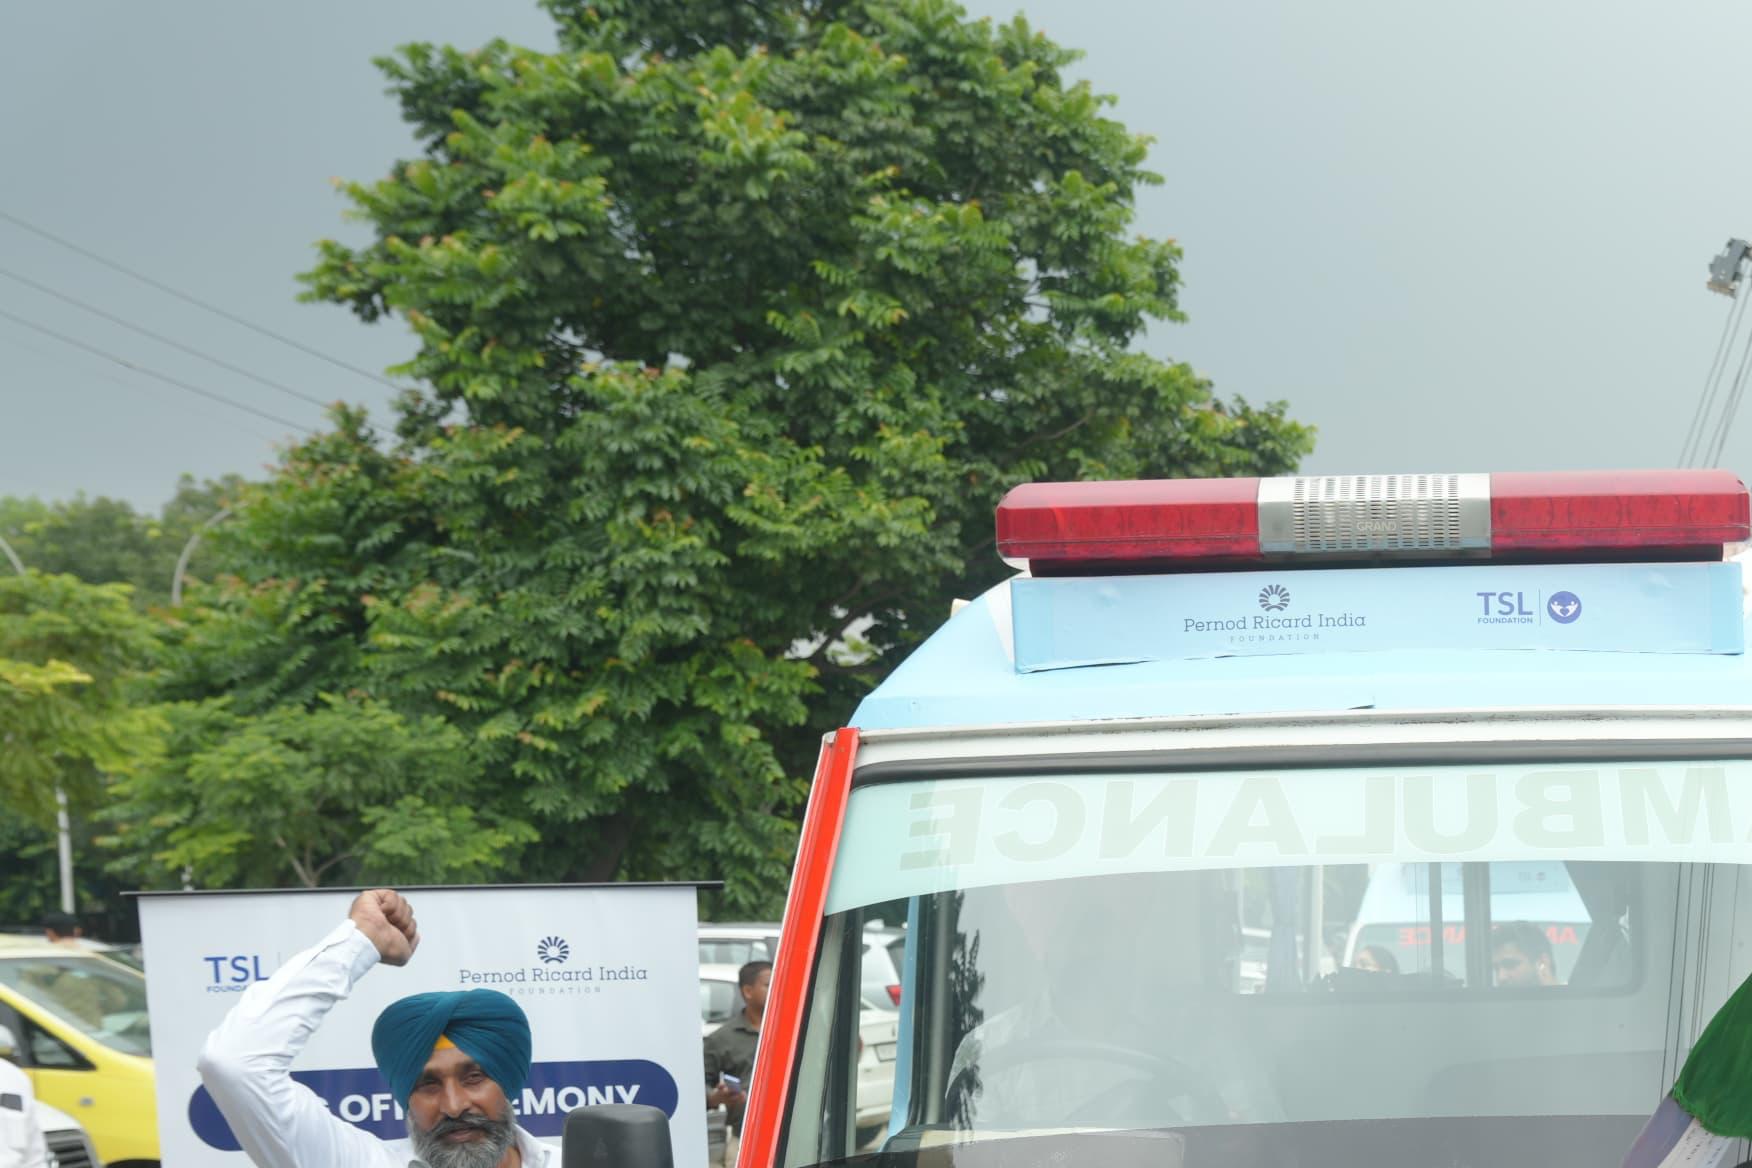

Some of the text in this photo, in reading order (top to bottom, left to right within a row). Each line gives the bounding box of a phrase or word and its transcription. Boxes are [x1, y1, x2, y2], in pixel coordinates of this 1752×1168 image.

[1356, 520, 1397, 532] GRAND
[1476, 591, 1533, 616] TSL
[1184, 612, 1367, 632] Pernod Ricard India
[1230, 632, 1320, 643] FOUNDATION
[203, 955, 270, 984] TSL
[459, 966, 648, 984] Pernod Ricard India
[511, 987, 600, 995] FOUNDATION
